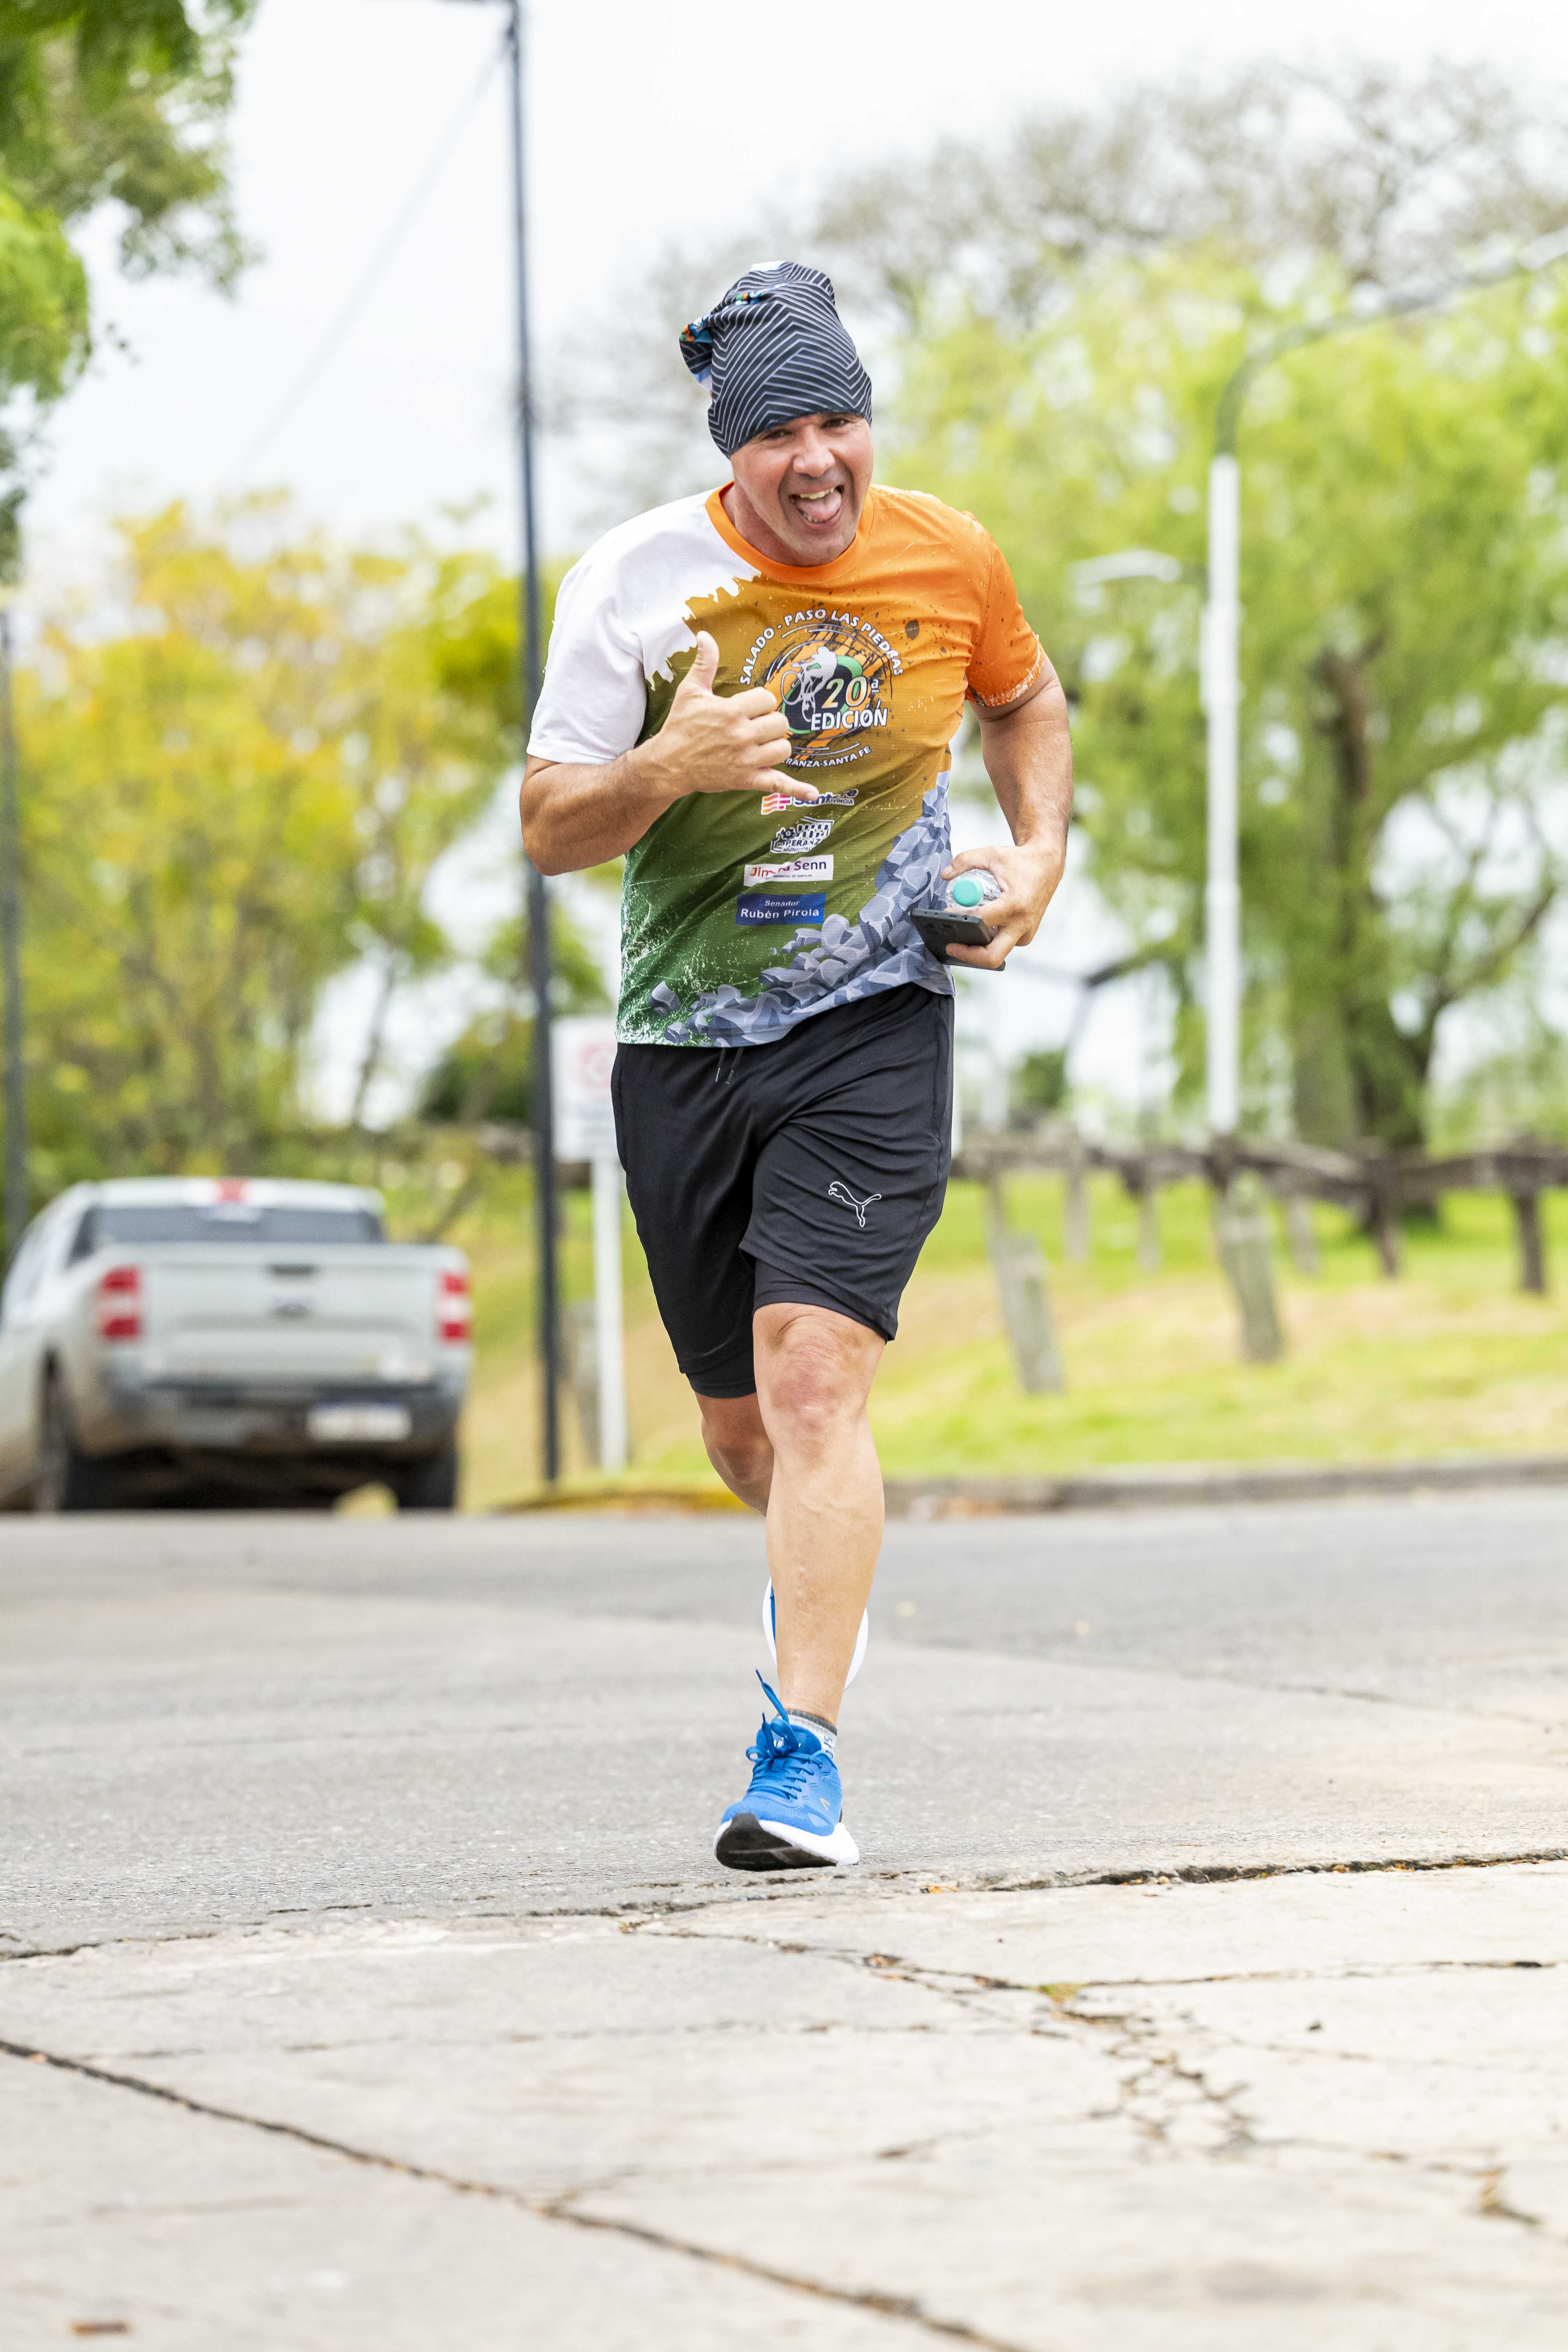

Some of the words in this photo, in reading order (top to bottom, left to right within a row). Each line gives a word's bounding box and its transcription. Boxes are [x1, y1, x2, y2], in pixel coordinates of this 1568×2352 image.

[739, 626, 775, 685] SALADO
[783, 608, 826, 626] PASO
[831, 609, 859, 627] LAS
[860, 623, 904, 676] PIEDRAS
[810, 700, 888, 732] EDICIÓN
[783, 753, 858, 768] RANZA-SANTA
[858, 746, 872, 757] FE
[794, 861, 827, 871] Senn
[740, 908, 779, 919] Rubén
[784, 909, 819, 917] Pirola
